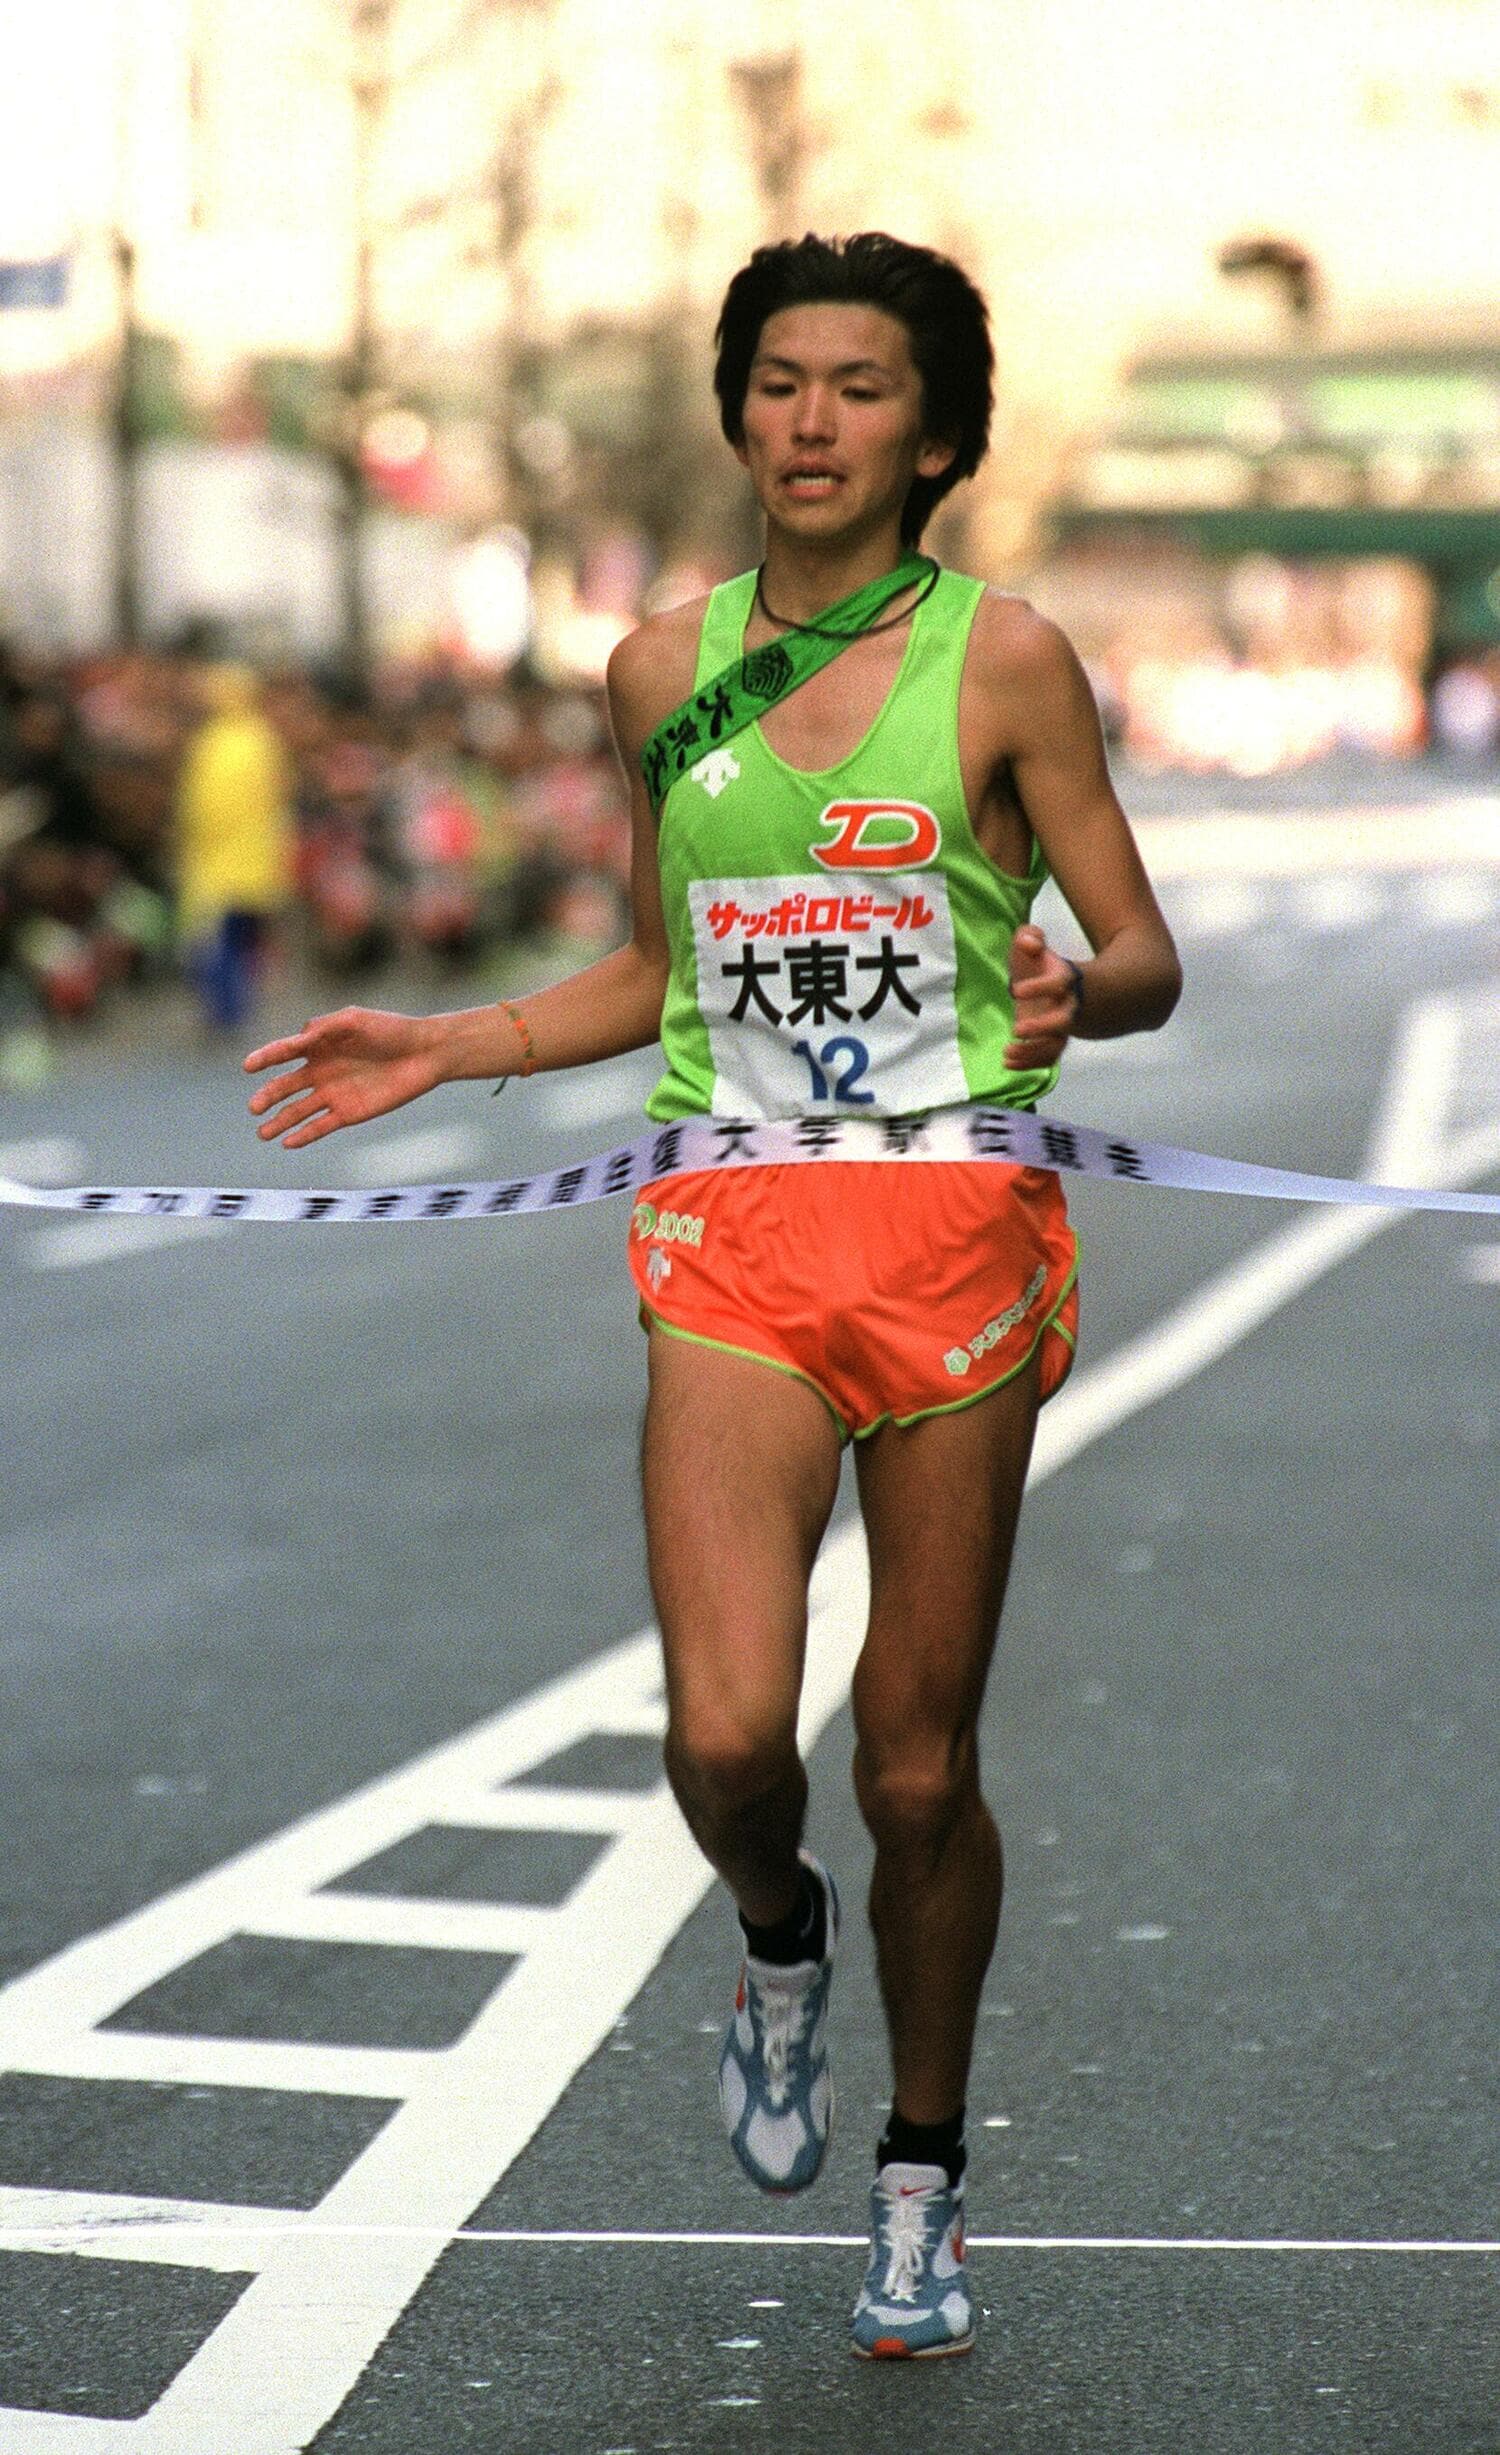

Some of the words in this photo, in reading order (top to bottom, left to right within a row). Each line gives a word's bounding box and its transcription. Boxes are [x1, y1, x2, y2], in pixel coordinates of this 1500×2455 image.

[810, 799, 941, 872] D
[706, 893, 935, 939] サッポロビール
[721, 936, 922, 1027] 大東大
[791, 1036, 875, 1104] 12
